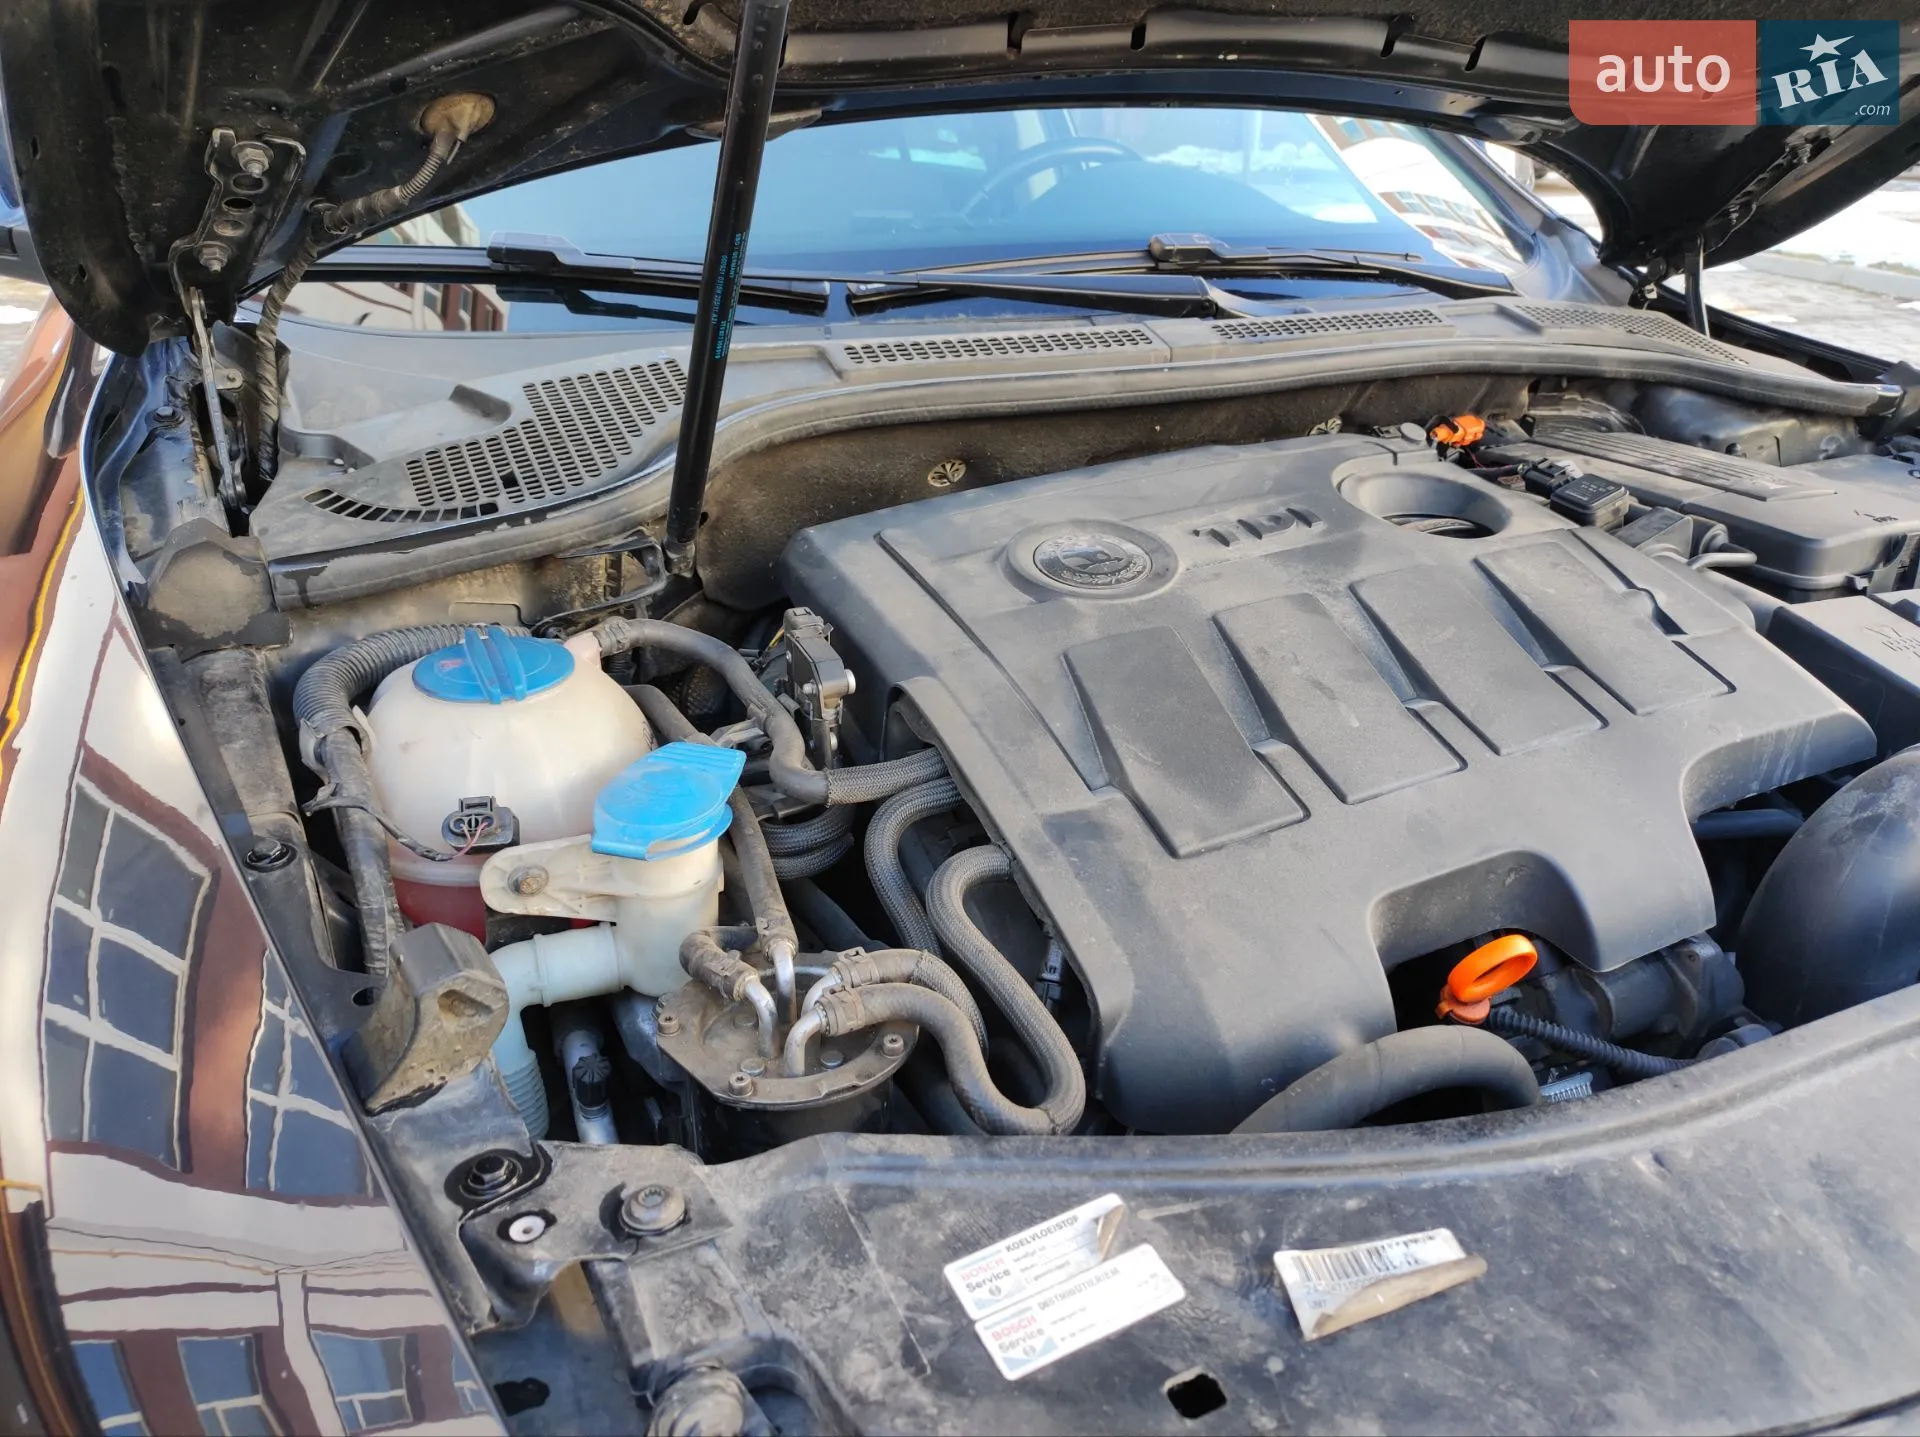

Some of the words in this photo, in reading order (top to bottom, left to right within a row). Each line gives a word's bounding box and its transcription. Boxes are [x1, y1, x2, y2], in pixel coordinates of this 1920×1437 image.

[960, 1257, 1005, 1282] BOSCH
[965, 1268, 1011, 1293] Service
[991, 1314, 1038, 1342] BOSCH
[998, 1328, 1045, 1354] Service
